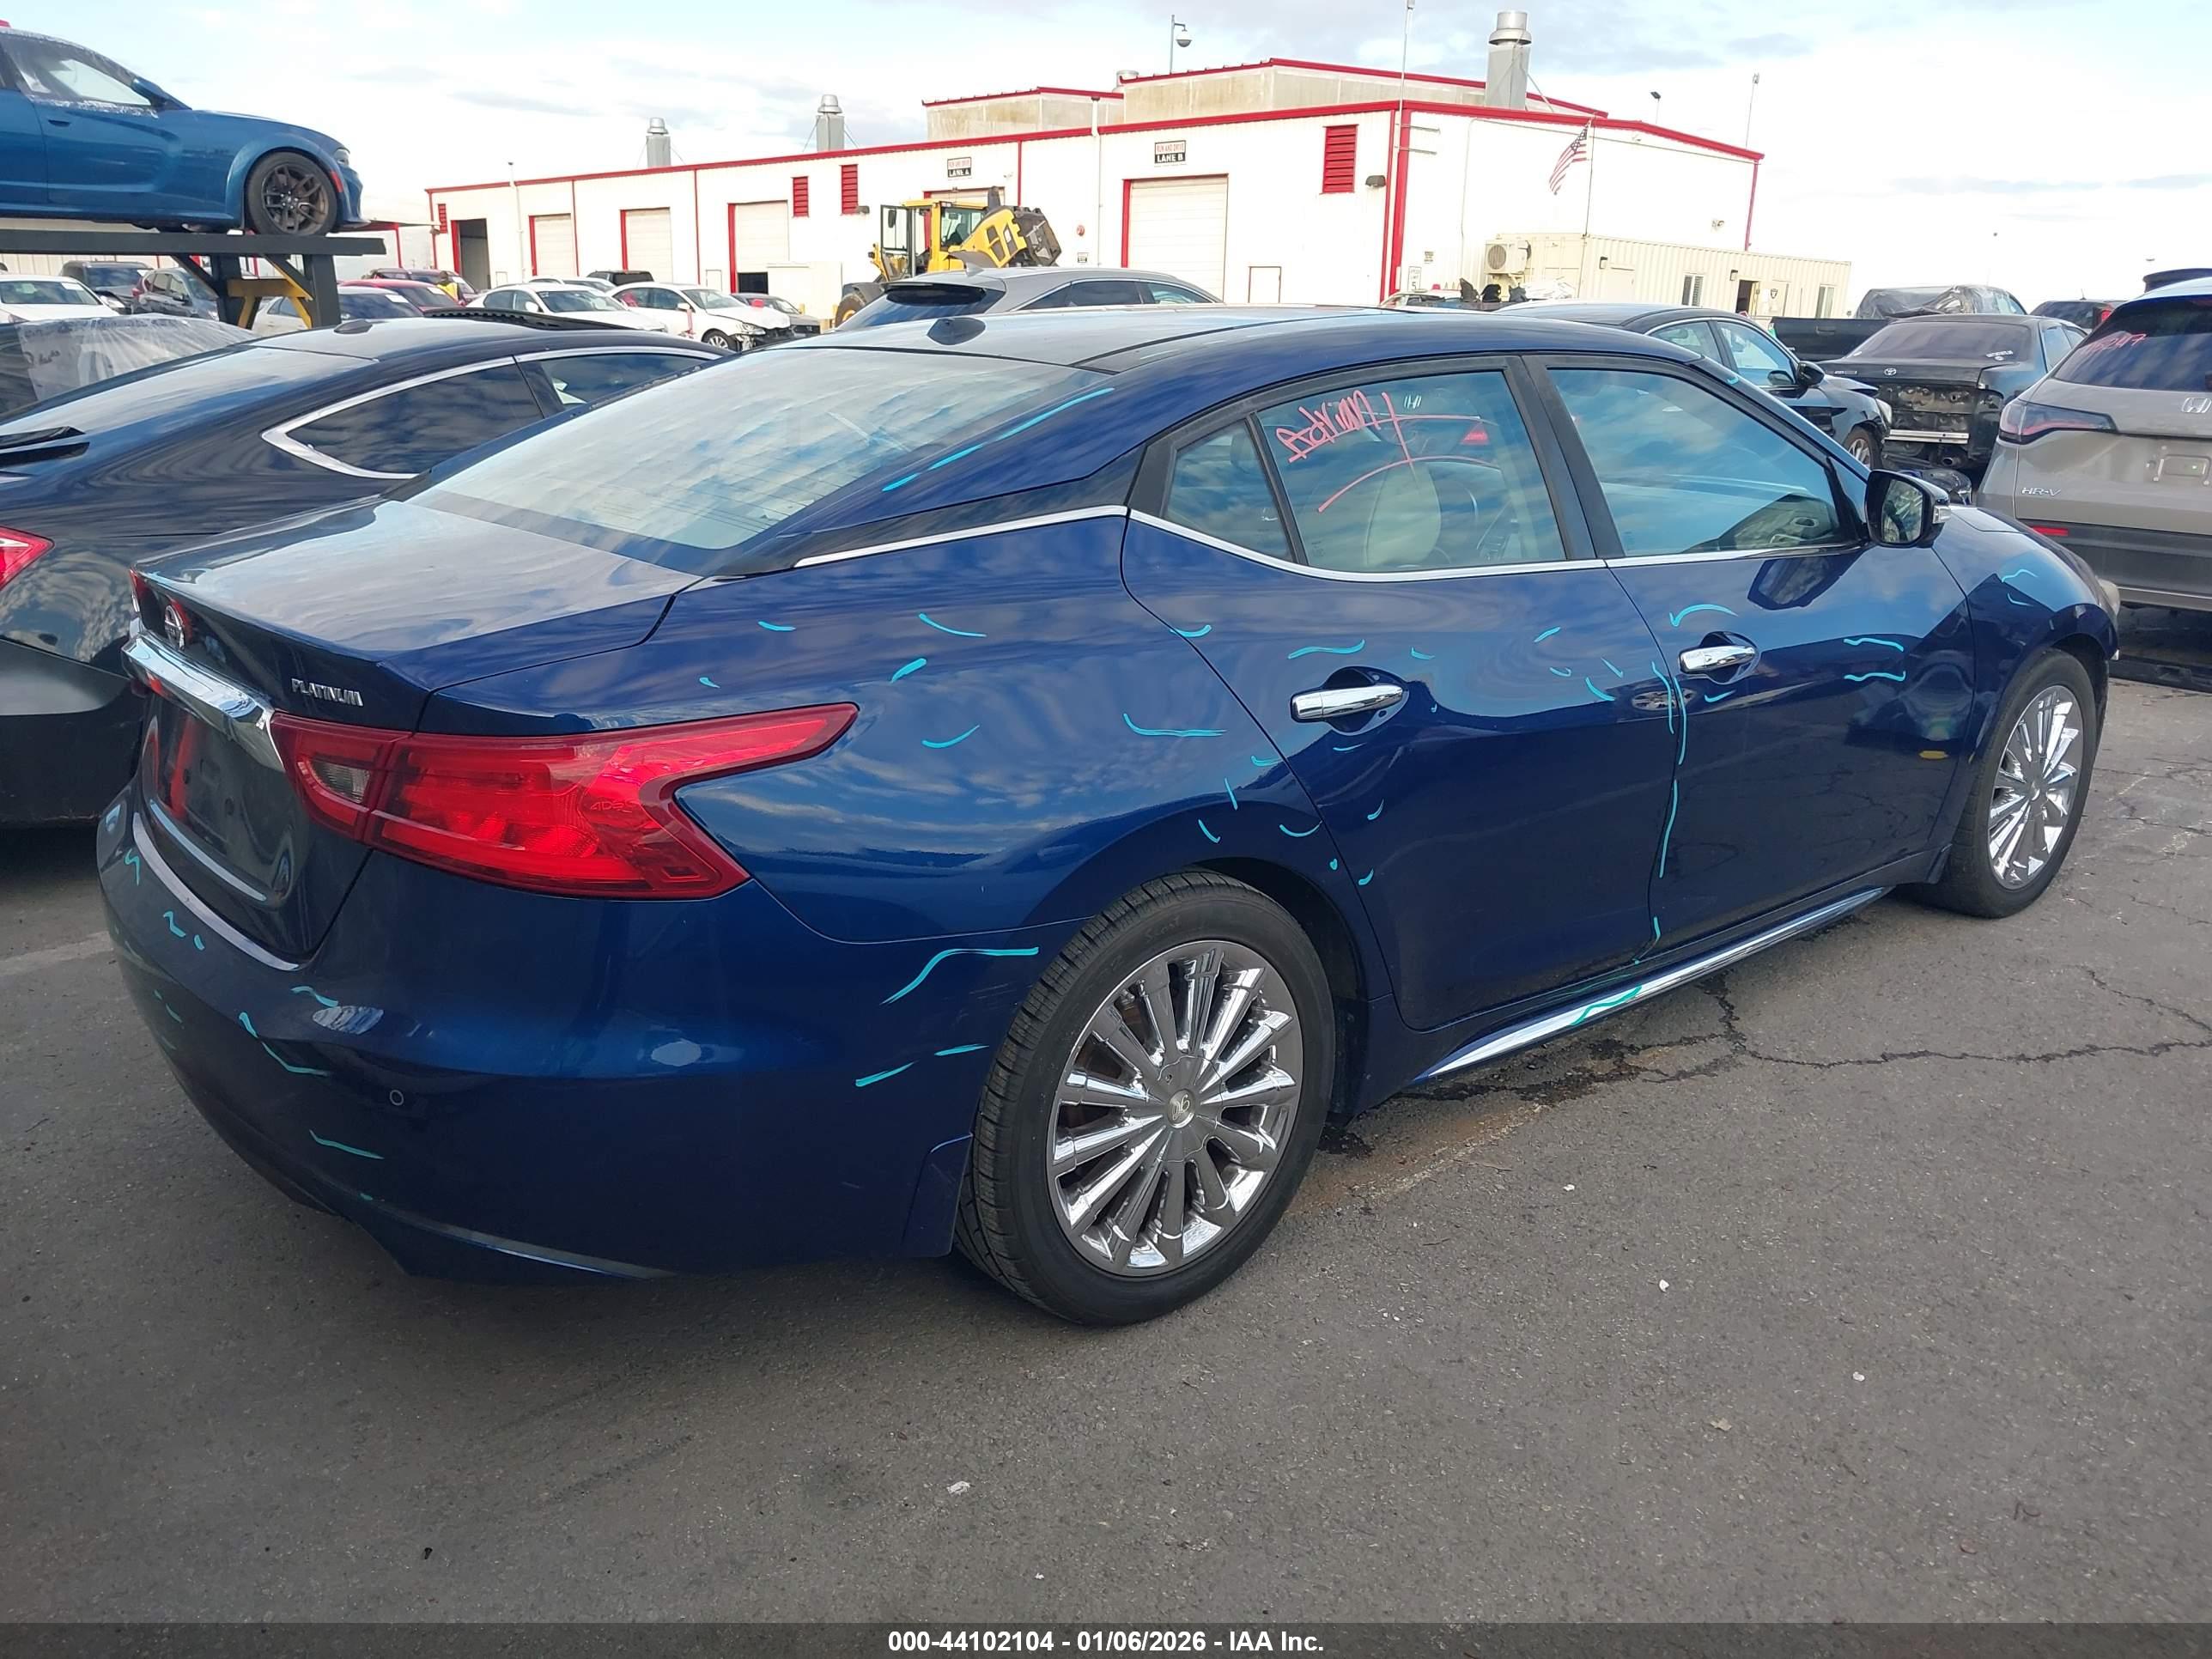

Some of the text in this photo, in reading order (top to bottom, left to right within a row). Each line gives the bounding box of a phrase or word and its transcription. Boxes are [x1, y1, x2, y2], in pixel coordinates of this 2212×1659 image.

[1157, 154, 1176, 162] LANE
[2021, 487, 2061, 496] HR-V
[291, 678, 363, 707] PLATINUM
